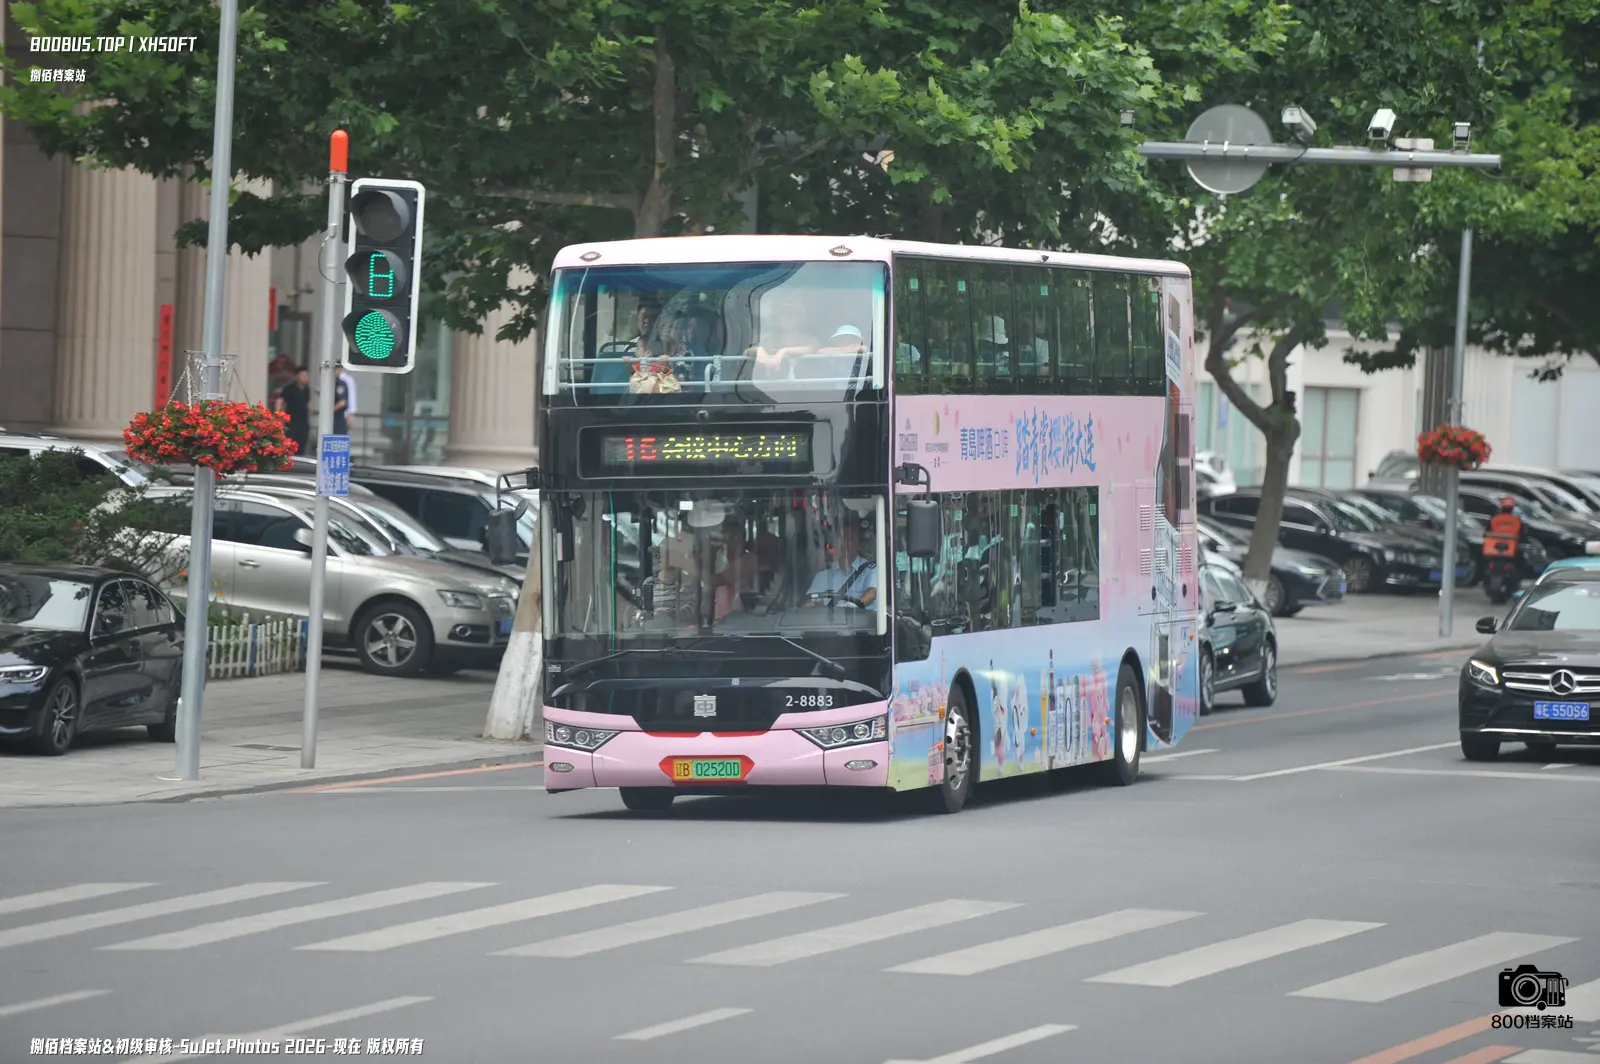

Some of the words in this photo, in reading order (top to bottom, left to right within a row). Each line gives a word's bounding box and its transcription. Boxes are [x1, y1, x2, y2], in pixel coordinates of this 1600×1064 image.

[786, 695, 834, 707] 2-8883
[1552, 703, 1588, 718] 550S6
[676, 762, 691, 777] 辽B
[695, 762, 740, 777] 02520D
